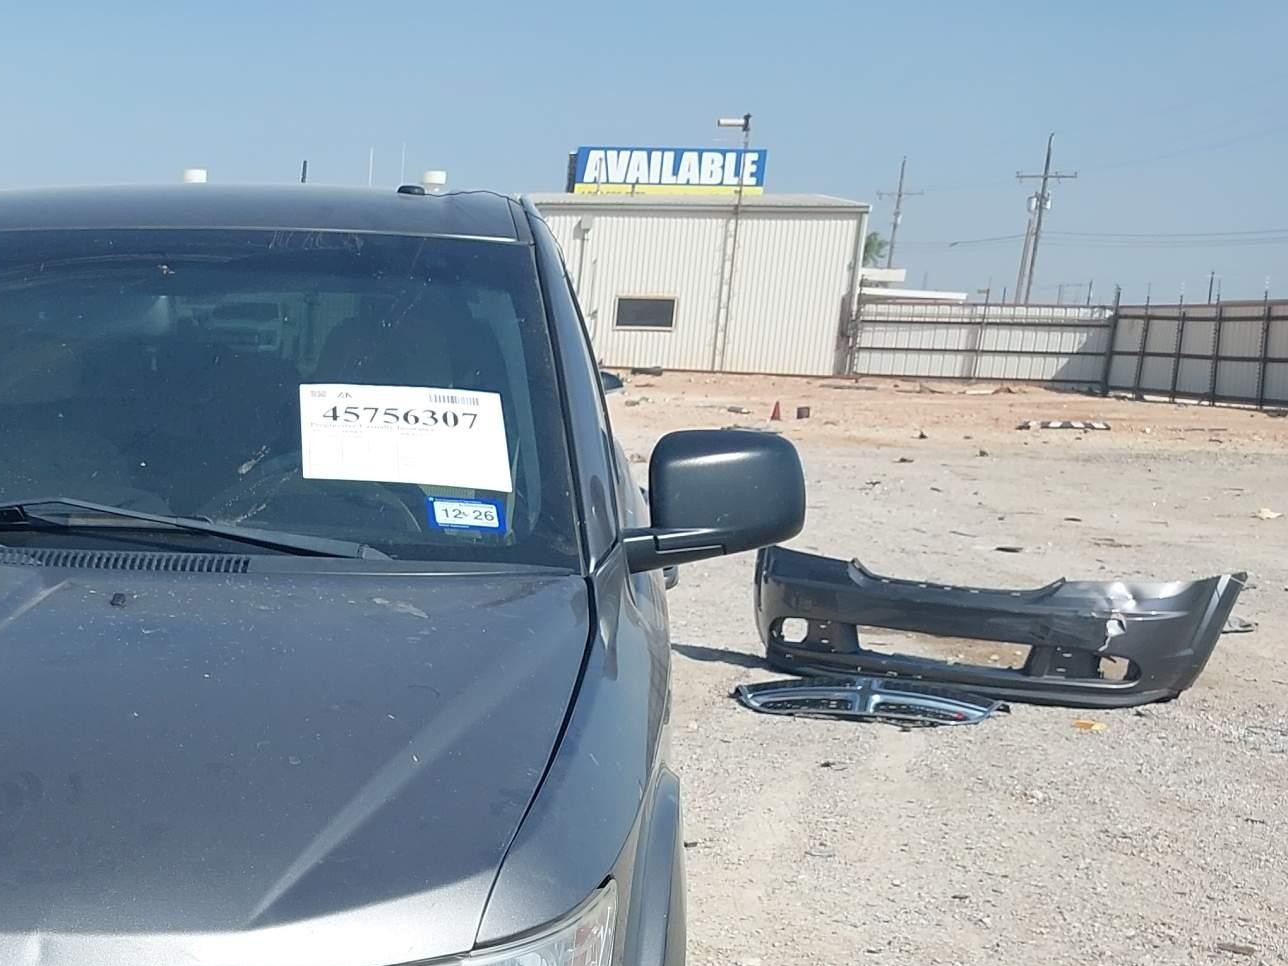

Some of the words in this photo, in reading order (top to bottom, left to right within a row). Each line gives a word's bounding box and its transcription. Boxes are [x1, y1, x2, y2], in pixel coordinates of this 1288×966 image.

[583, 150, 759, 185] AVAILABLE
[322, 405, 479, 430] 45756307
[441, 508, 464, 519] 12
[472, 510, 495, 521] 26
